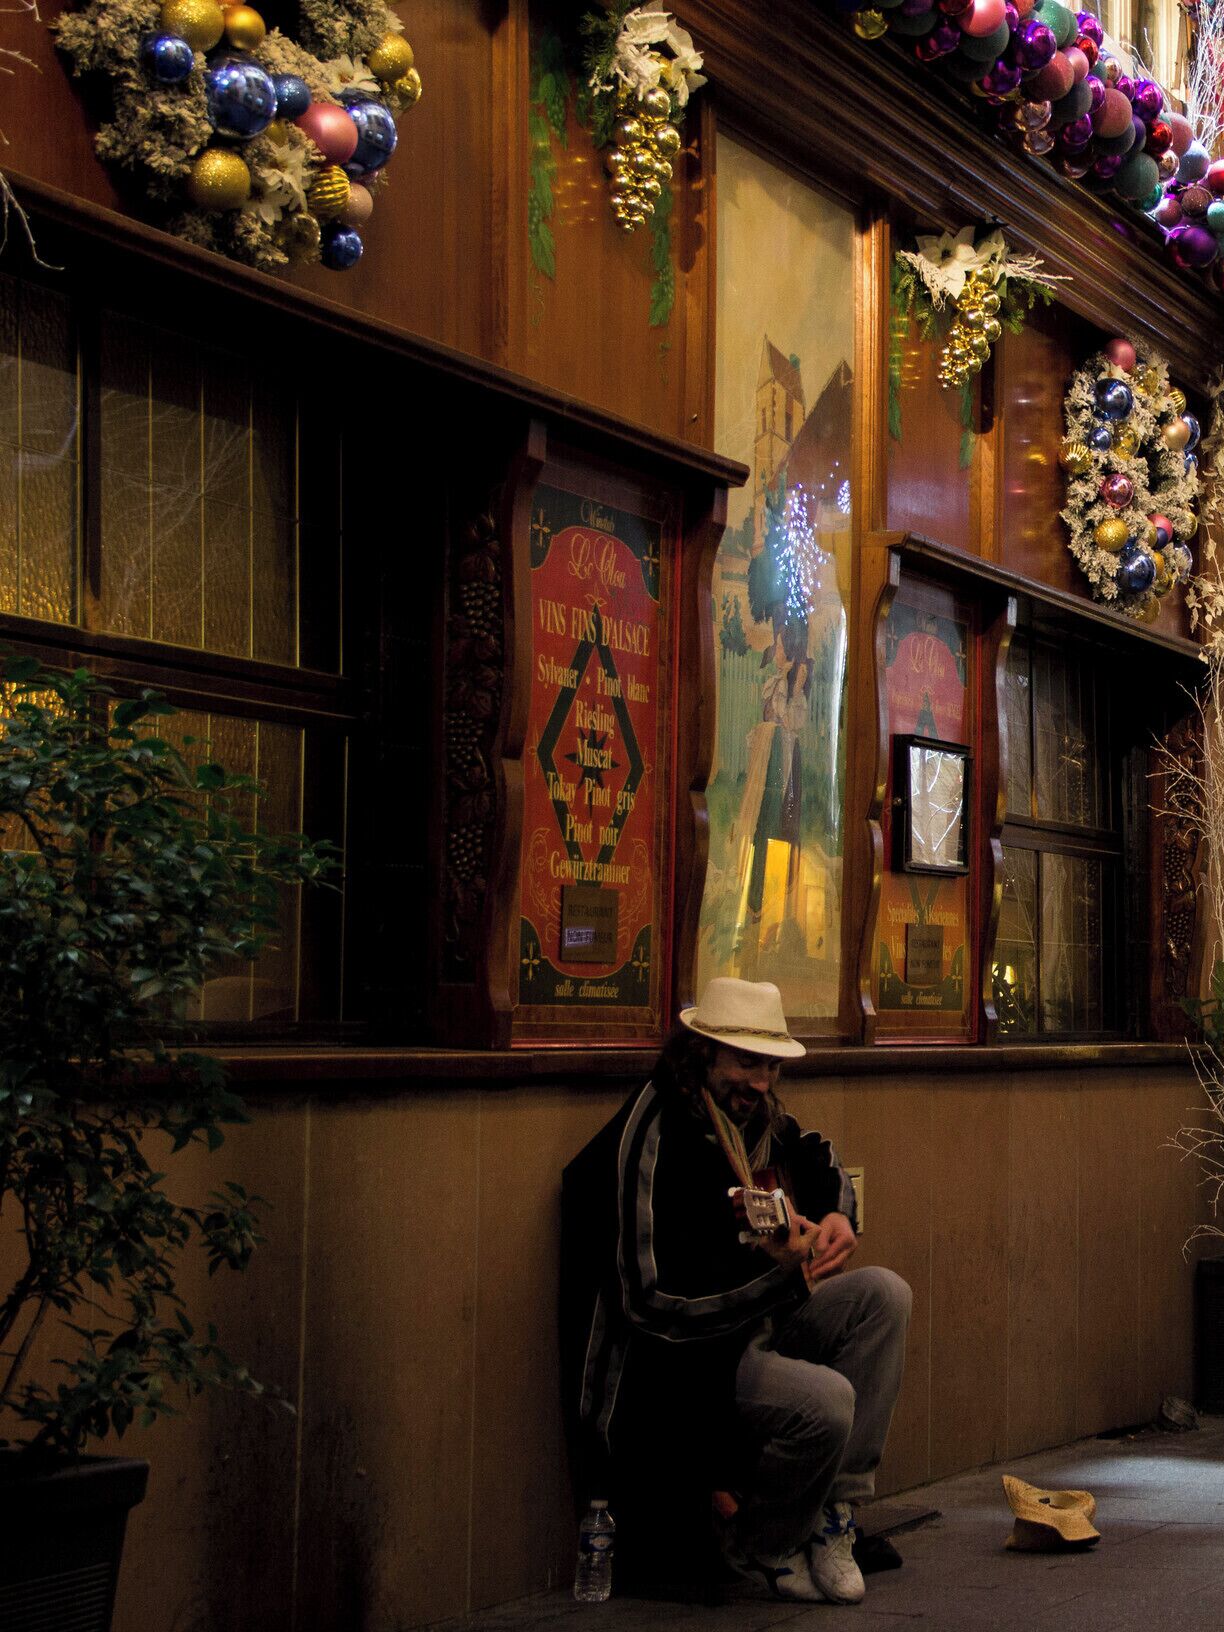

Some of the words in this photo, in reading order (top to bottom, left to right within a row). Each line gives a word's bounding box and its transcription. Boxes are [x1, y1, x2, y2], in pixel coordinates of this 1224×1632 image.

[568, 533, 593, 579] Le
[594, 535, 626, 589] Clou
[540, 599, 566, 636] VINS
[572, 607, 596, 643] FINS
[602, 616, 650, 656] D'ALSACE
[538, 654, 578, 689] Sylvaner
[597, 667, 621, 698] Pinot
[627, 674, 649, 703] blanc
[576, 700, 615, 739] Riesling
[576, 738, 612, 769] Muscat
[547, 772, 576, 808] Tokay
[584, 778, 611, 808] Pinot
[617, 784, 636, 815] gris
[566, 814, 593, 843] Pinot
[599, 822, 618, 845] noir
[550, 851, 630, 884] Gewürztraminer
[555, 980, 574, 997] salle
[580, 980, 620, 999] climatisée
